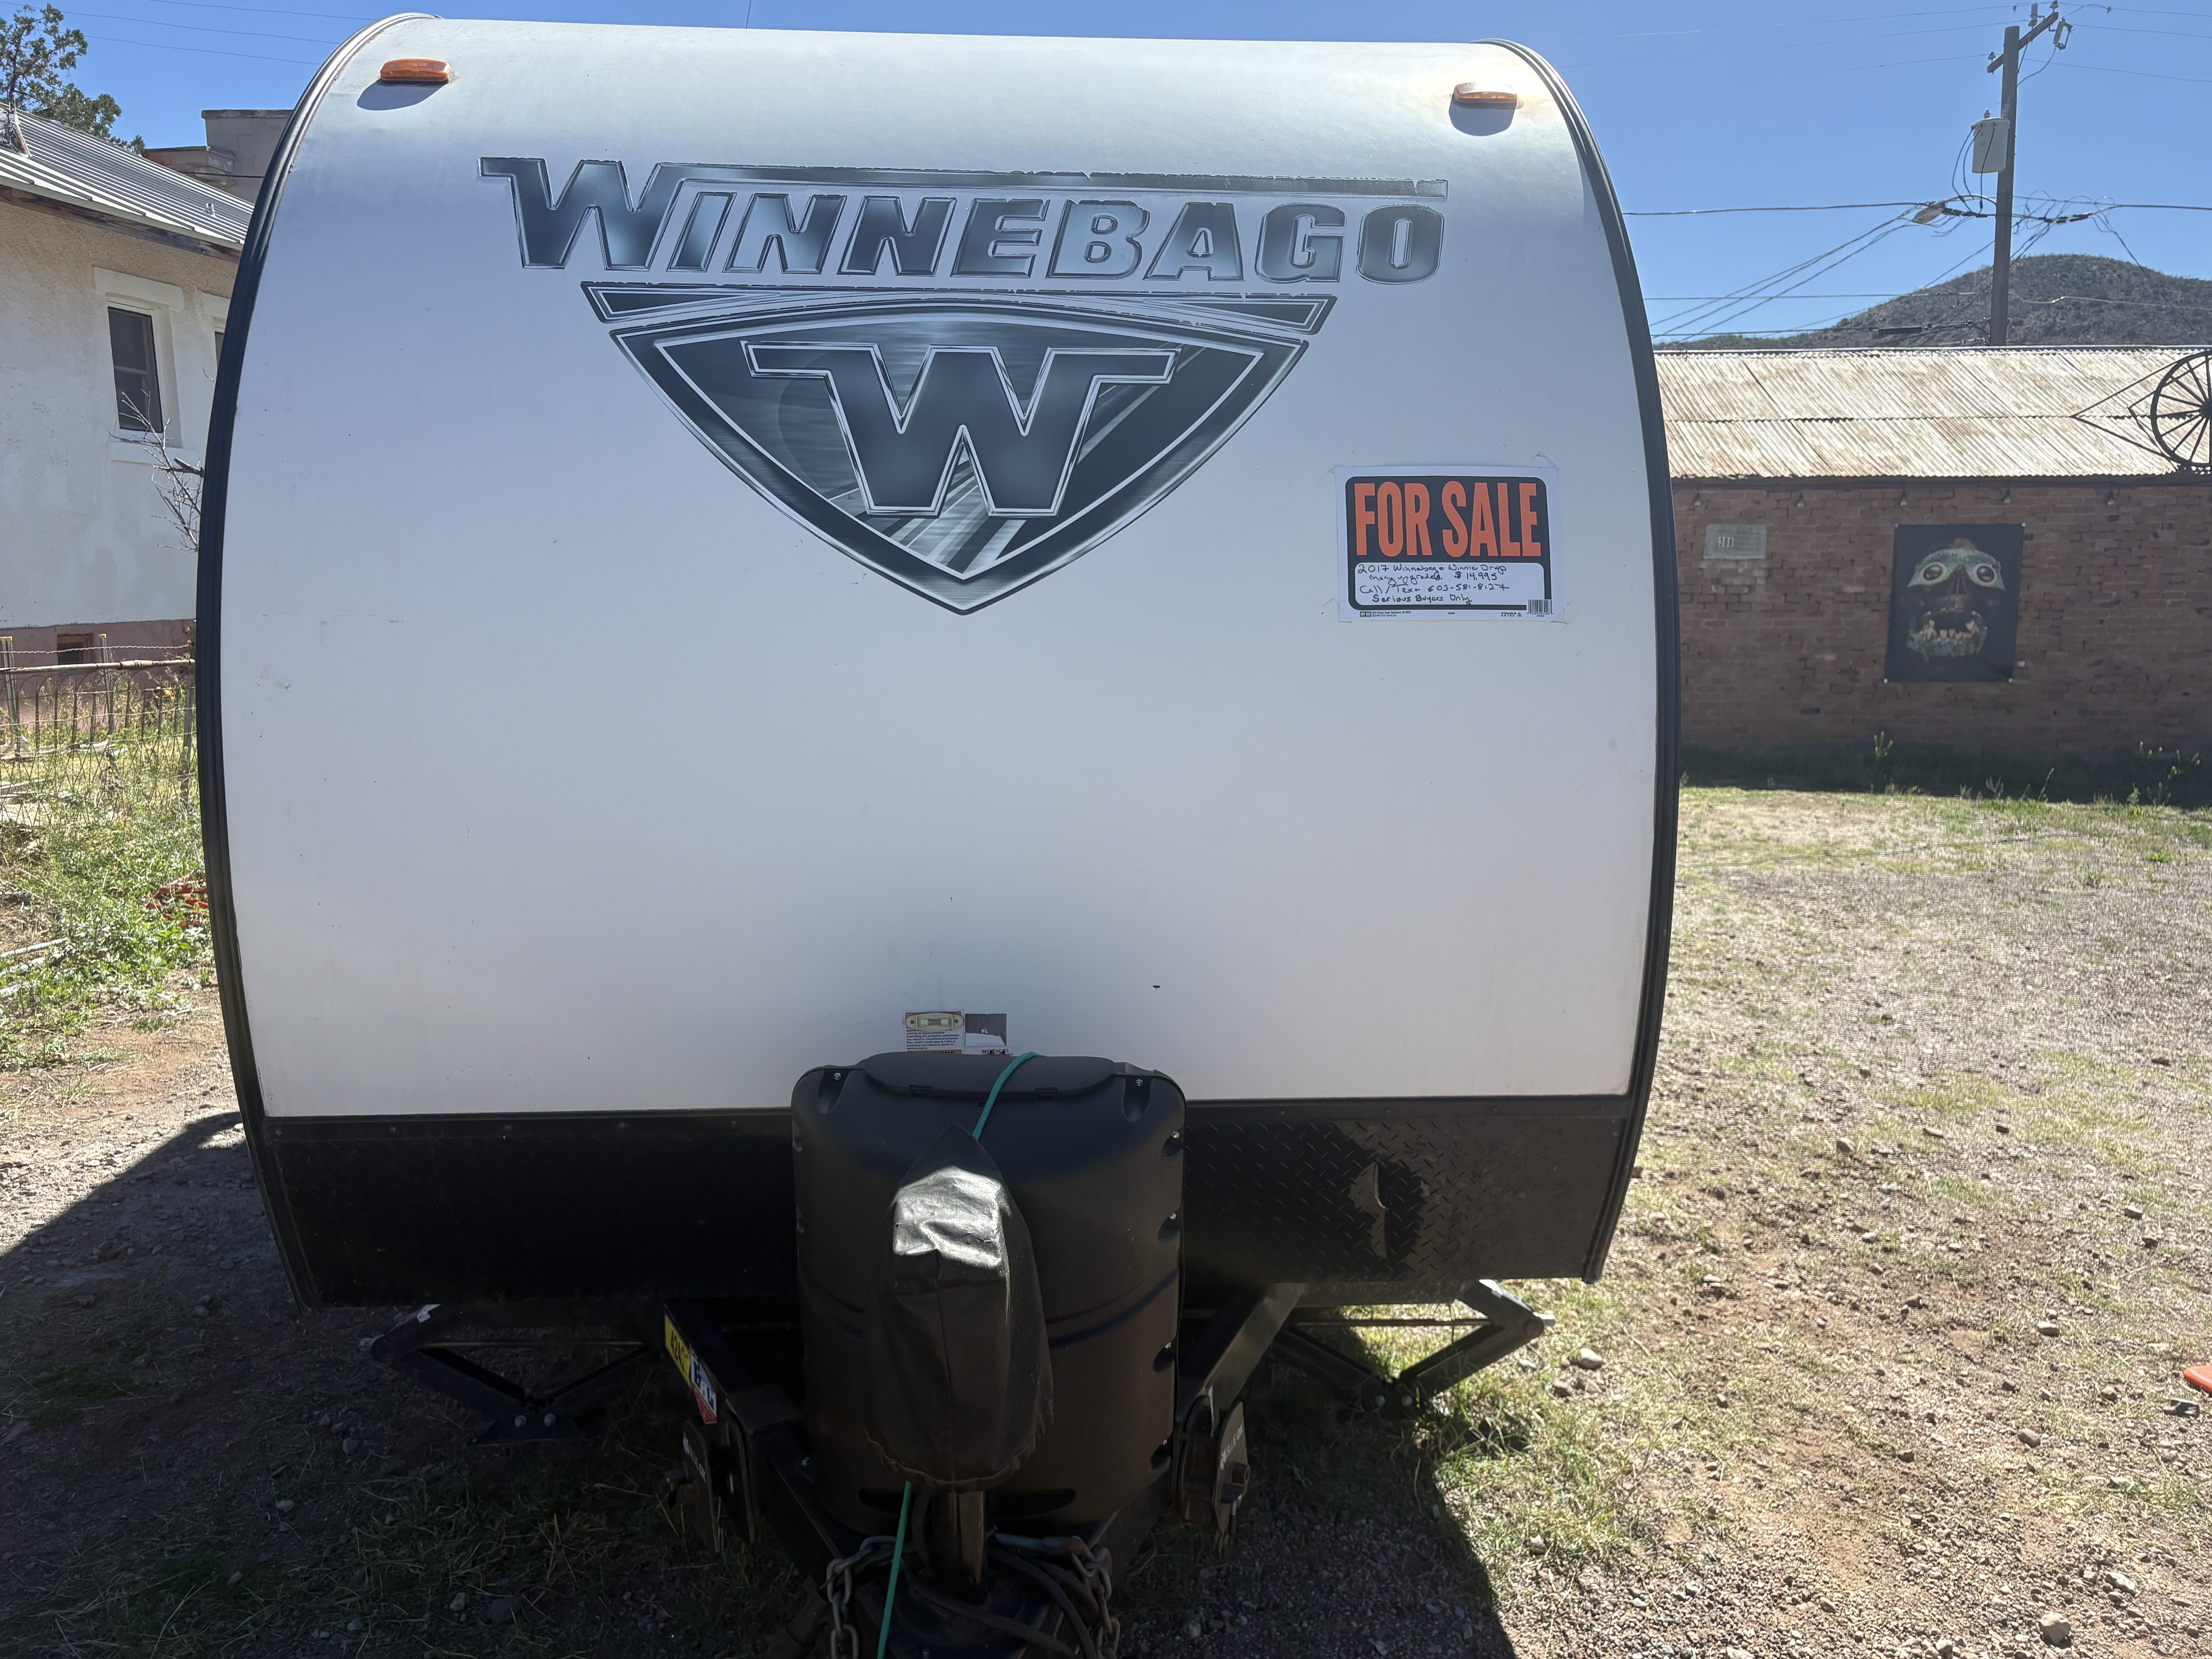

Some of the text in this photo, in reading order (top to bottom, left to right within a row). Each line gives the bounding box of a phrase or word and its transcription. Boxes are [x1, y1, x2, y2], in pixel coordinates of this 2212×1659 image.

[478, 156, 1448, 285] WINNEBAGO
[740, 340, 1182, 519] W
[1354, 481, 1541, 558] FOR SALE
[1358, 564, 1389, 574] 2017
[1393, 563, 1444, 577] Winnebago
[1428, 583, 1510, 592] 603-581-8127
[1372, 594, 1472, 605] Serious Buyers Only
